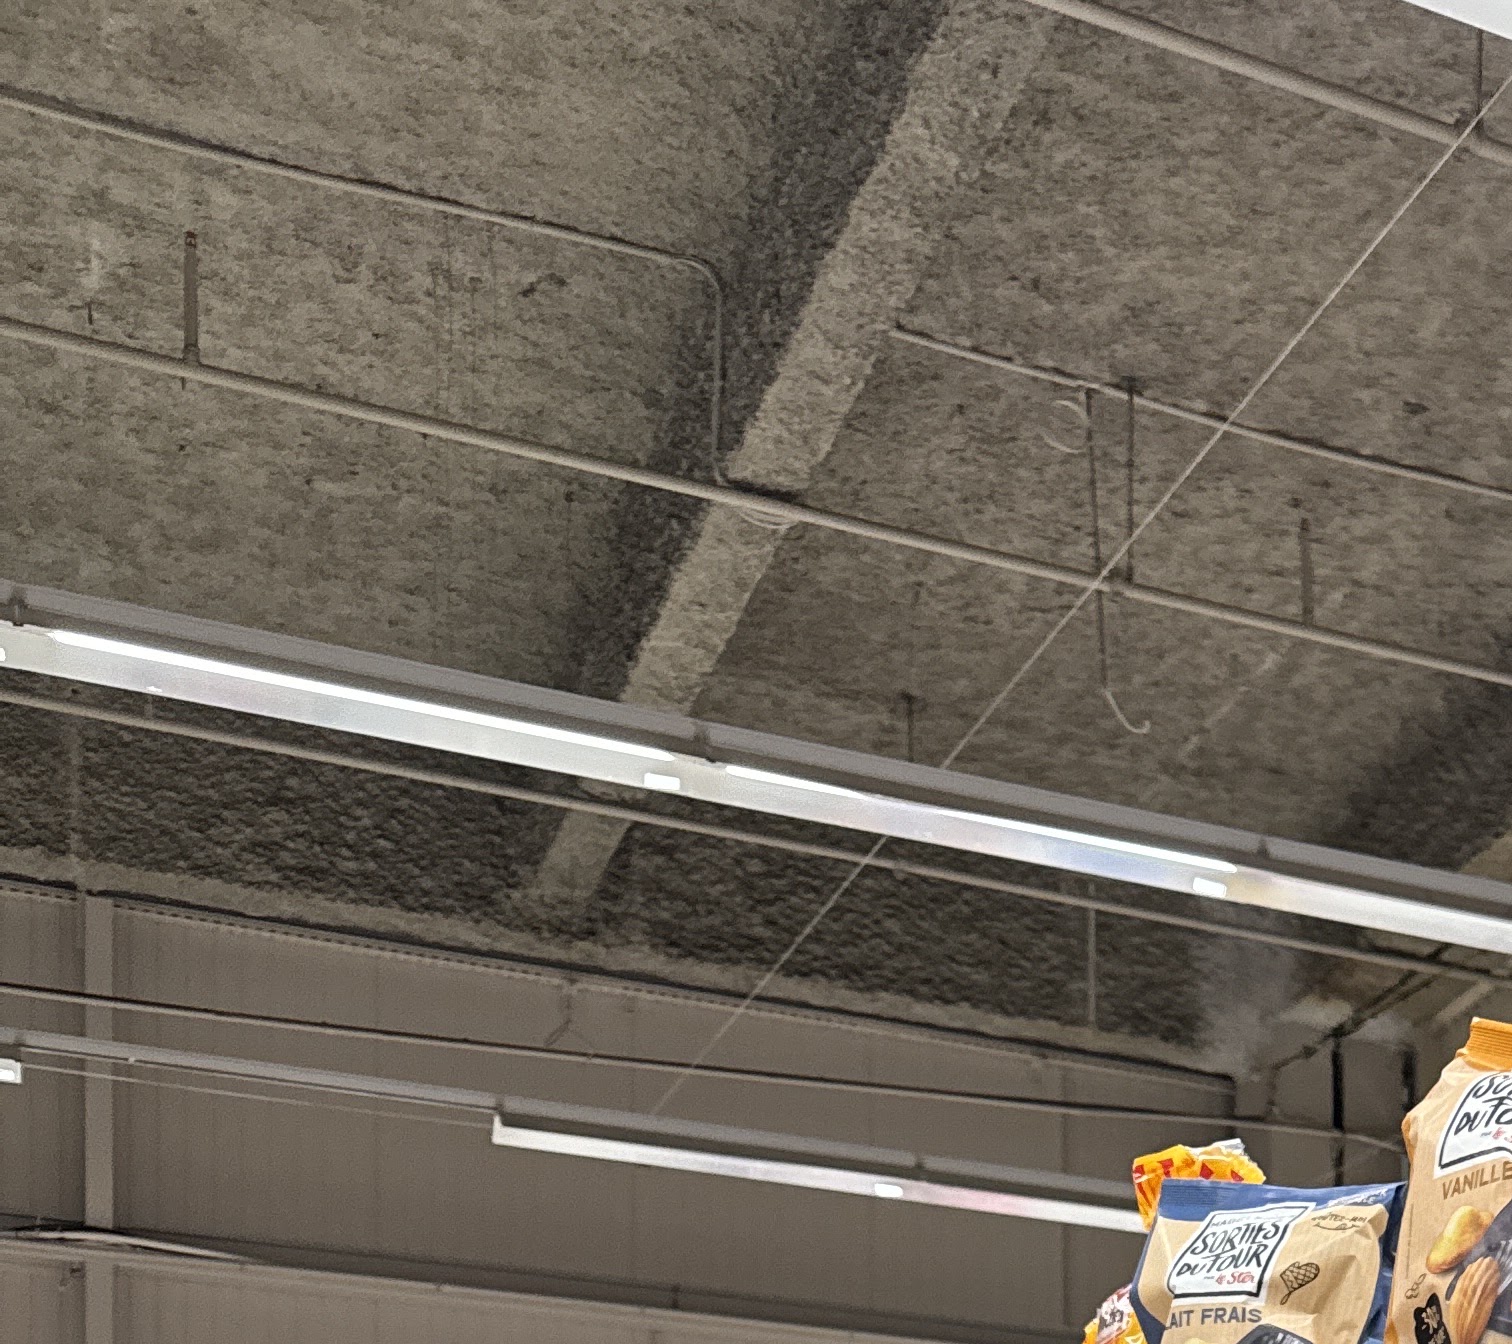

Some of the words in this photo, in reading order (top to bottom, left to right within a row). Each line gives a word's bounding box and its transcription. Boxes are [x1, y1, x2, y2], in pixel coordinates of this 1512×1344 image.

[1454, 1110, 1488, 1136] DU
[1191, 1221, 1280, 1255] SORTIES
[1176, 1258, 1208, 1276] DU
[1206, 1243, 1271, 1275] TOUR
[1200, 1306, 1263, 1324] FRAIS
